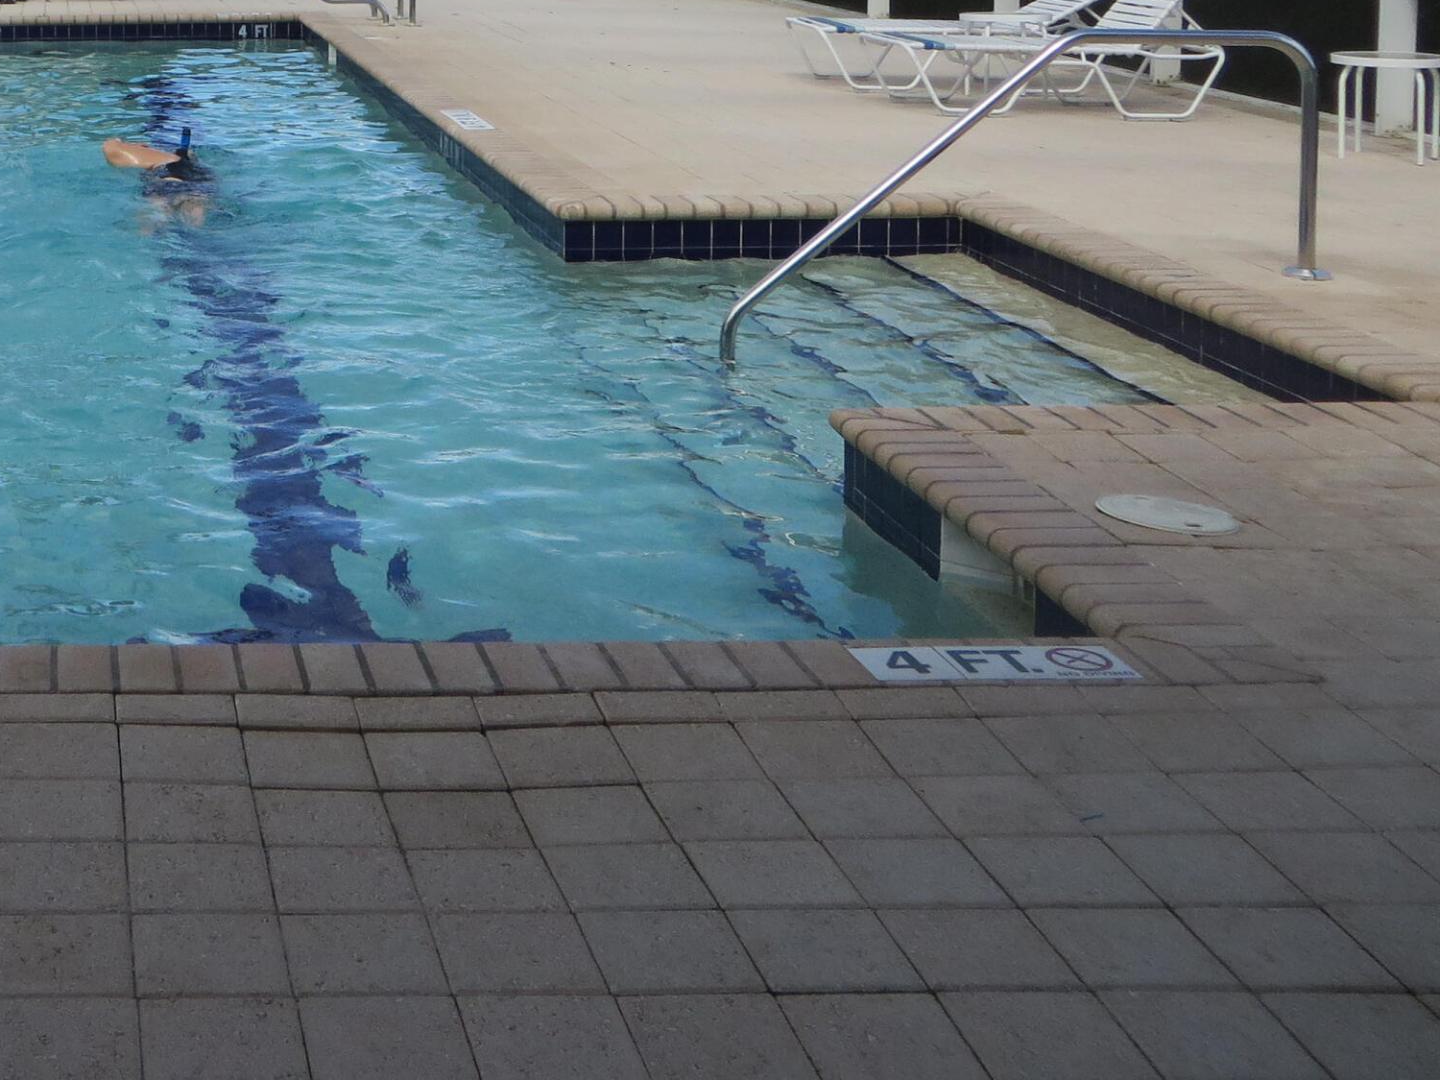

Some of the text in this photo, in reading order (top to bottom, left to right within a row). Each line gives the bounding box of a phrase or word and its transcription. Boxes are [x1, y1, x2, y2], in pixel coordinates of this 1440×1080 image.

[238, 24, 268, 38] 4 FT
[885, 649, 1043, 674] 4 FT.
